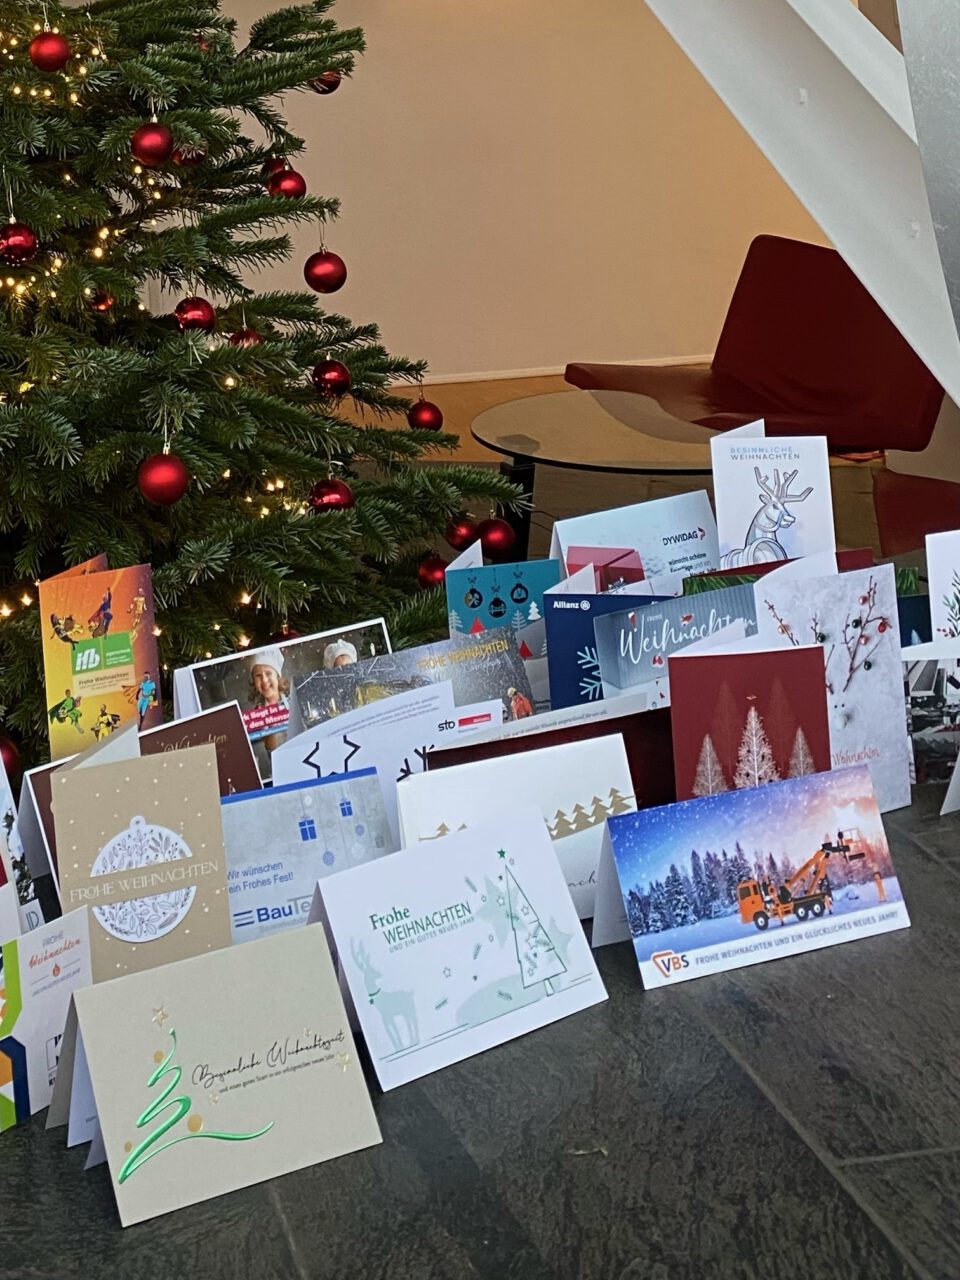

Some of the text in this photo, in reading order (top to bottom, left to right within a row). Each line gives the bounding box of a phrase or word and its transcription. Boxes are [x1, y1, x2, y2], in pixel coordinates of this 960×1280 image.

[662, 530, 698, 546] DYWIDAG
[553, 600, 579, 609] Allianz
[620, 608, 756, 664] Weihnachtn
[75, 648, 100, 671] ifb
[448, 640, 509, 664] WEIHNACHTEN
[95, 672, 129, 682] Weihnachten
[438, 720, 455, 731] sto
[70, 860, 219, 902] FROHE WEIHNACHTEN
[227, 862, 283, 880] Wir wünschen
[228, 871, 294, 894] ein Frohes Fest!
[369, 906, 410, 930] Frohe
[383, 901, 472, 945] WEIHNACHTEN
[389, 944, 403, 953] UND
[404, 939, 416, 947] EIN
[417, 932, 437, 943] GUTES
[439, 924, 458, 934] NEUES
[696, 953, 719, 965] FROHE
[721, 941, 773, 959] WEIHNACHTEN
[775, 937, 789, 946] UND
[791, 933, 804, 943] EIN
[804, 921, 852, 939] GLÜCKLICHES
[854, 916, 876, 927] NEUES
[661, 954, 690, 973] VBS
